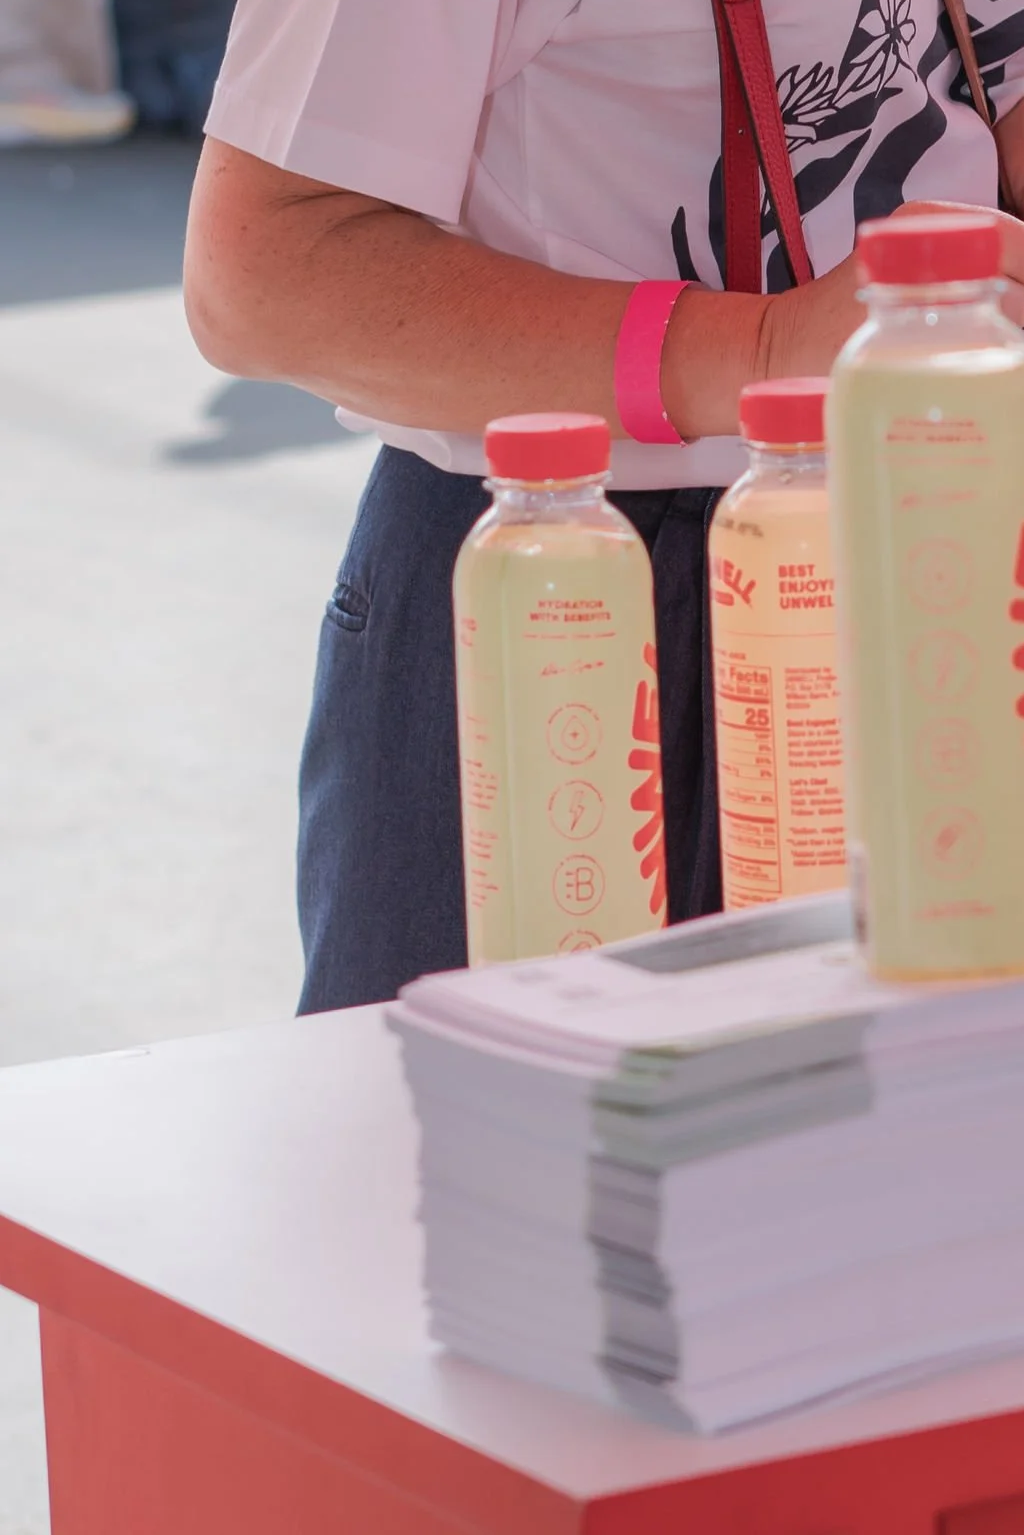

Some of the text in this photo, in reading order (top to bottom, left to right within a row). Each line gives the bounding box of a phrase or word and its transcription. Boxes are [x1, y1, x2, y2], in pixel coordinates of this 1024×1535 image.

[778, 564, 815, 578] BEST
[730, 666, 768, 684] Facts
[745, 707, 769, 726] 25
